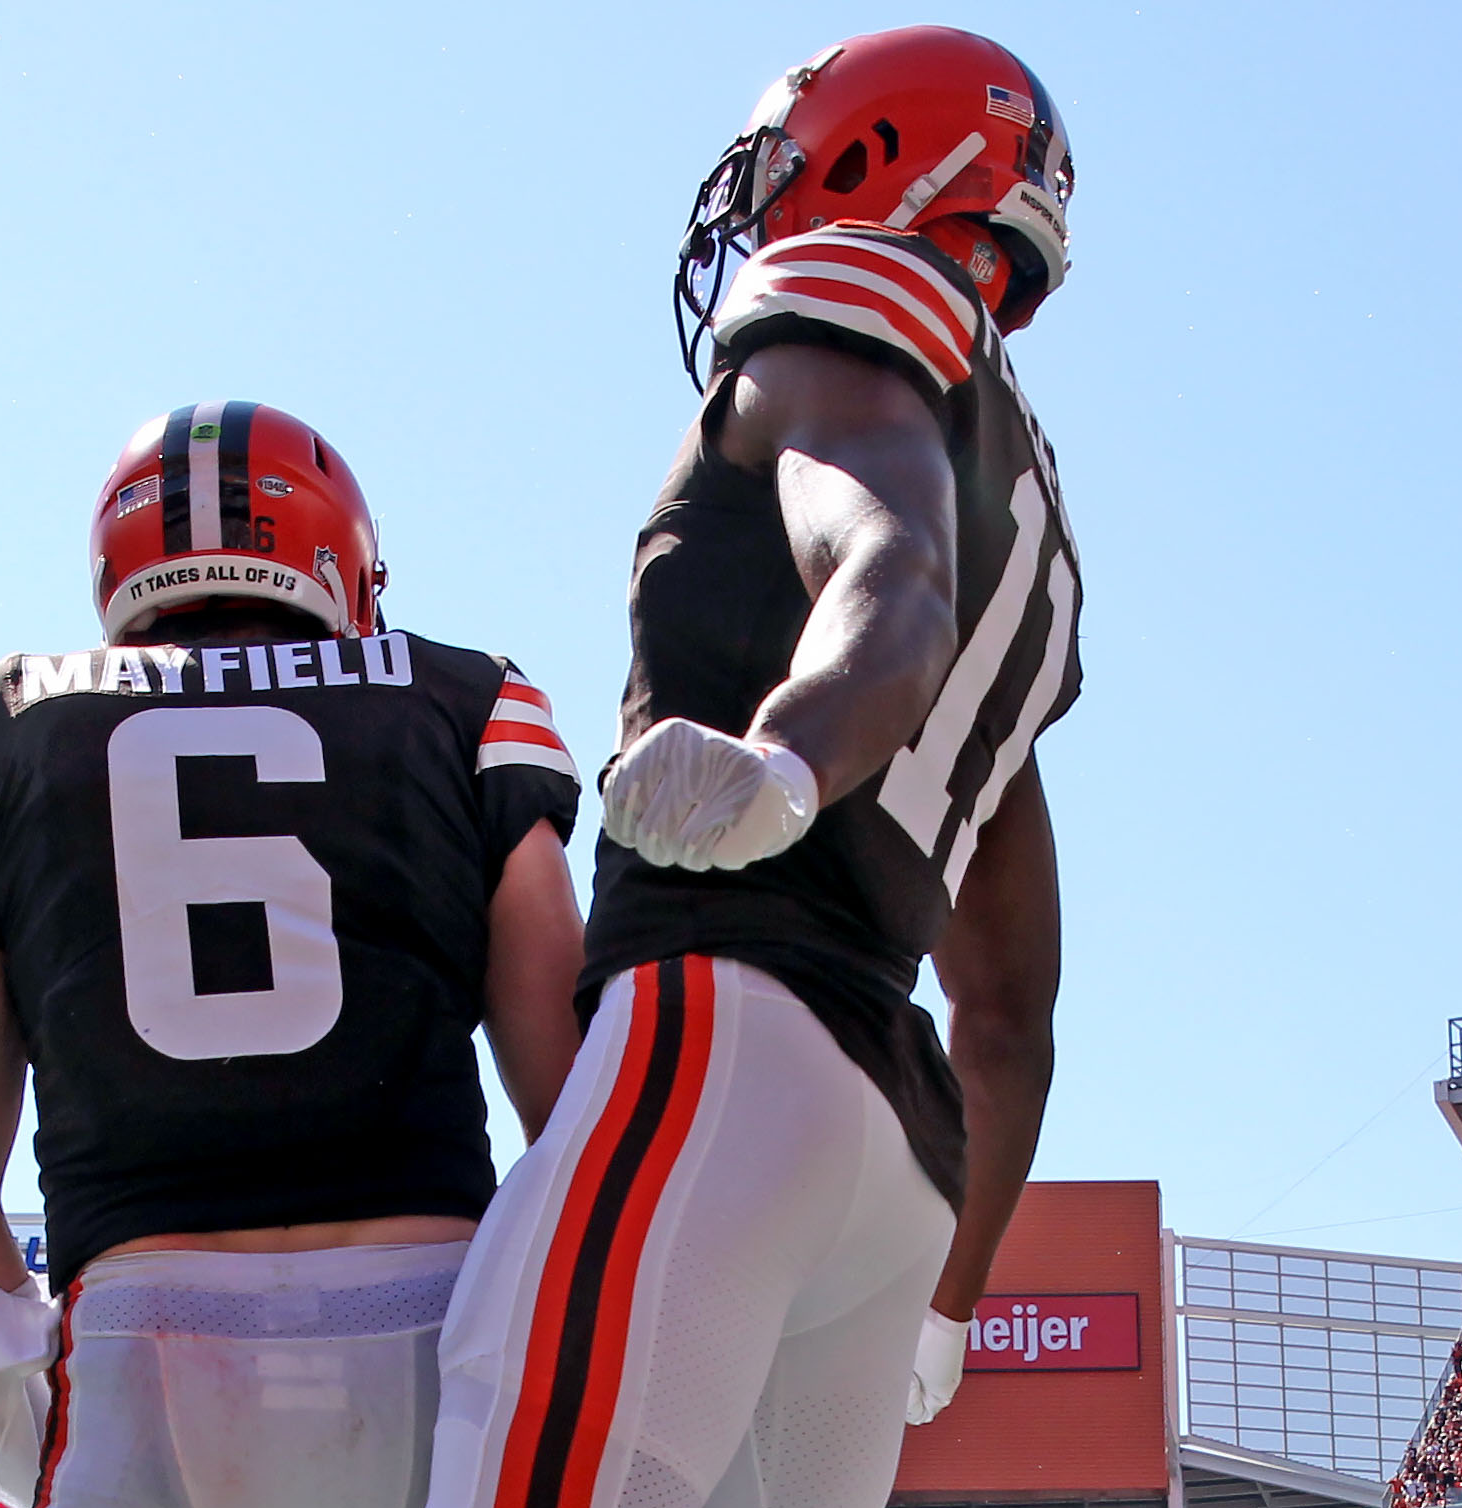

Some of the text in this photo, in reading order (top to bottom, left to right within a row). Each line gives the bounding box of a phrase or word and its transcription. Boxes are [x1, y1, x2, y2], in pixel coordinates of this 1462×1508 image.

[253, 516, 276, 553] 6
[130, 566, 296, 600] IT TAKES ALL OF US
[20, 631, 413, 702] MAYFIELD
[107, 705, 343, 1060] 6
